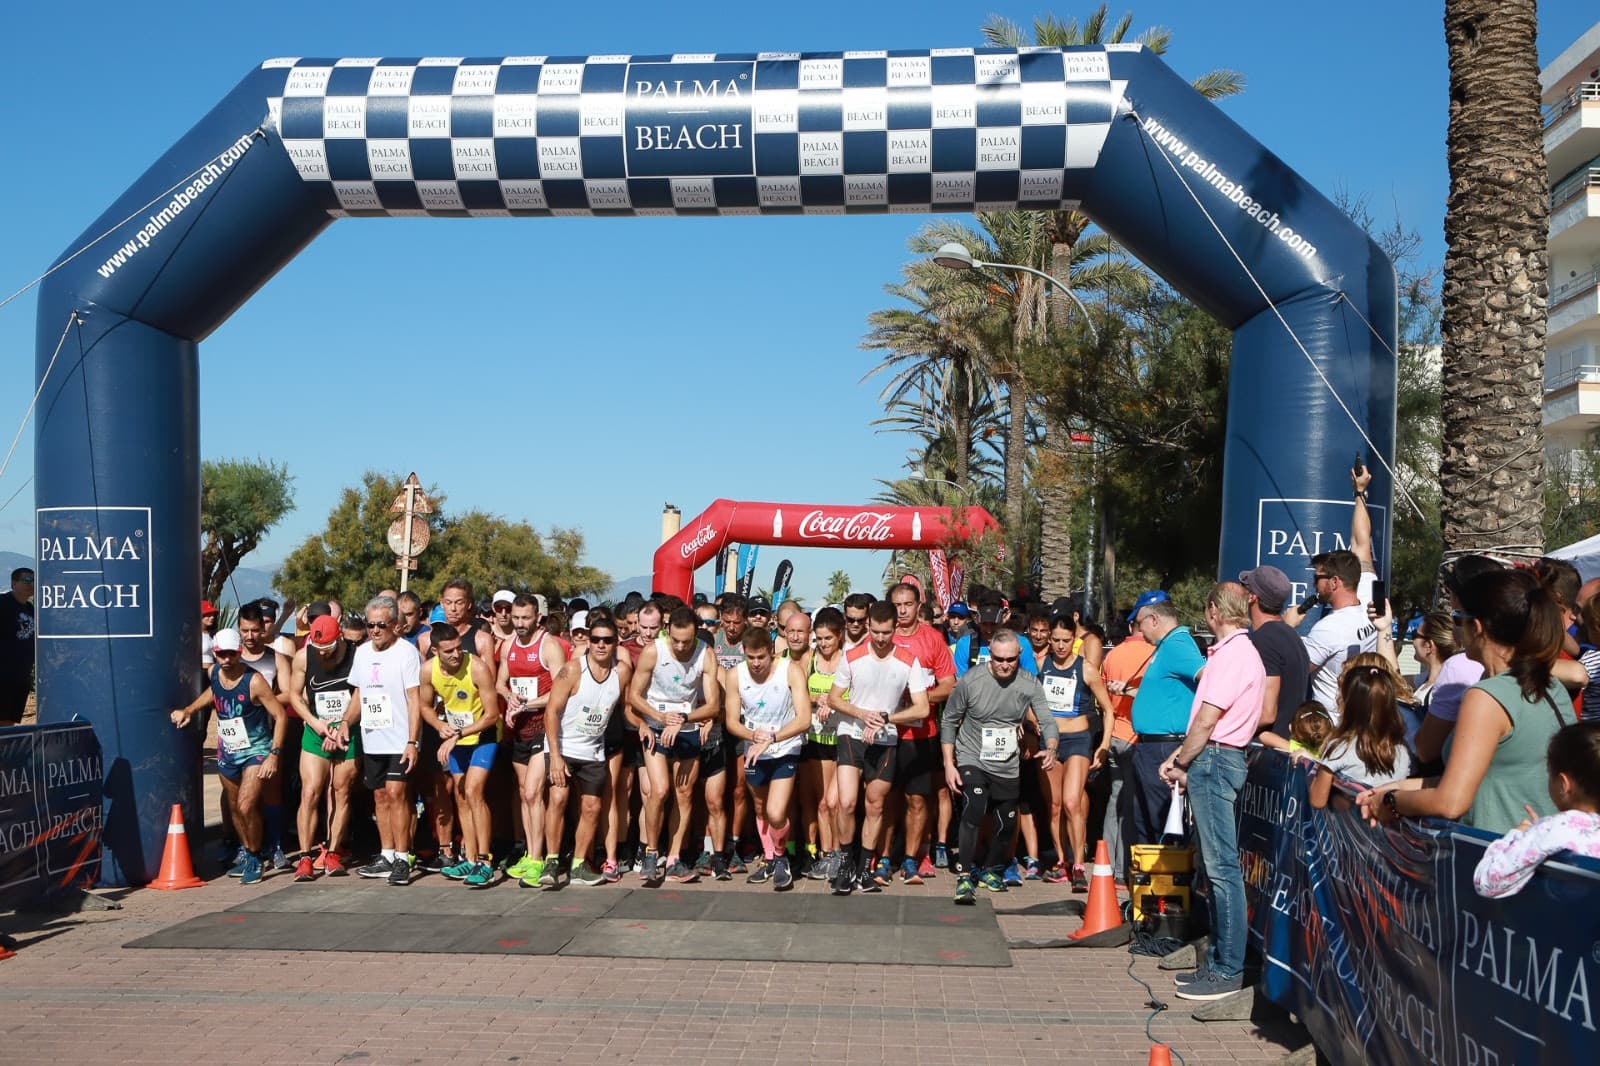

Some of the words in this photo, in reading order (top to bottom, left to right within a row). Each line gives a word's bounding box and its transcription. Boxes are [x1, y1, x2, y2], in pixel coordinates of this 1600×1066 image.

[980, 68, 1016, 76] BEACH
[1069, 66, 1105, 74] BEACH
[457, 80, 492, 88] BEACH
[936, 109, 972, 118] BEACH
[1026, 106, 1062, 116] BEACH
[759, 114, 794, 123] BEACH
[847, 112, 882, 121] BEACH
[328, 120, 362, 129] BEACH
[412, 120, 446, 129] BEACH
[498, 119, 532, 128] BEACH
[584, 118, 618, 126] BEACH
[635, 124, 742, 150] BEACH
[892, 140, 928, 149] PALMA
[980, 138, 1016, 146] PALMA
[542, 147, 576, 156] PALMA
[803, 142, 839, 152] PALMA
[372, 148, 406, 158] PALMA
[456, 148, 490, 157] PALMA
[892, 155, 927, 165] BEACH
[981, 153, 1016, 162] BEACH
[544, 162, 578, 171] BEACH
[804, 158, 839, 167] BEACH
[374, 164, 408, 172] BEACH
[458, 163, 492, 172] BEACH
[936, 180, 970, 188] PALMA
[1024, 177, 1059, 185] PALMA
[338, 188, 373, 196] PALMA
[421, 188, 456, 196] PALMA
[761, 184, 796, 192] PALMA
[1143, 117, 1317, 259] www.palmabeach.com
[97, 134, 254, 279] www.palmabeach.com
[799, 510, 896, 542] Coca-Cola
[681, 524, 718, 558] Coca-Cola
[41, 536, 140, 560] PALMA
[41, 584, 140, 608] BEACH
[326, 700, 342, 709] 328
[368, 704, 382, 713] 195
[587, 714, 602, 722] 409
[222, 728, 236, 736] 493
[995, 737, 1006, 746] 85
[48, 756, 102, 788] PALMA
[1244, 783, 1280, 824] PALMA
[50, 805, 104, 840] BEACH
[1460, 910, 1596, 1032] PALMA
